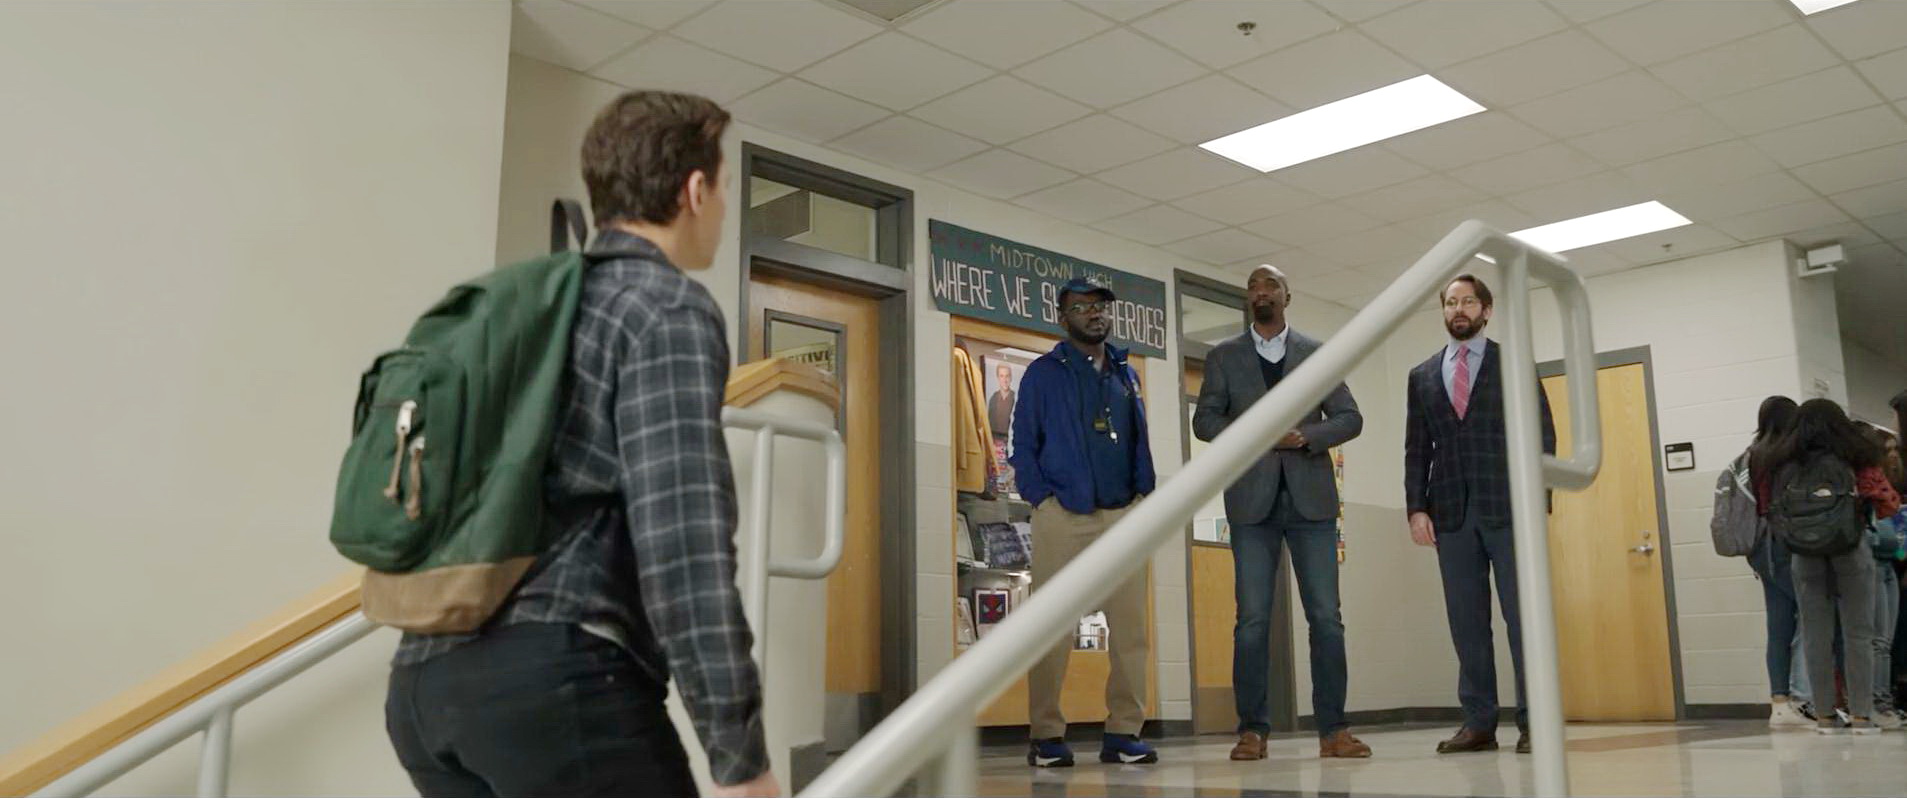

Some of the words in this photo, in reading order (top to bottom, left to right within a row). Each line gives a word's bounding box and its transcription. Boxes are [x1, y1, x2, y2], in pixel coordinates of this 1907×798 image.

[931, 253, 996, 310] WHERE
[1001, 274, 1032, 318] WE
[990, 243, 1073, 280] MIDTOWN
